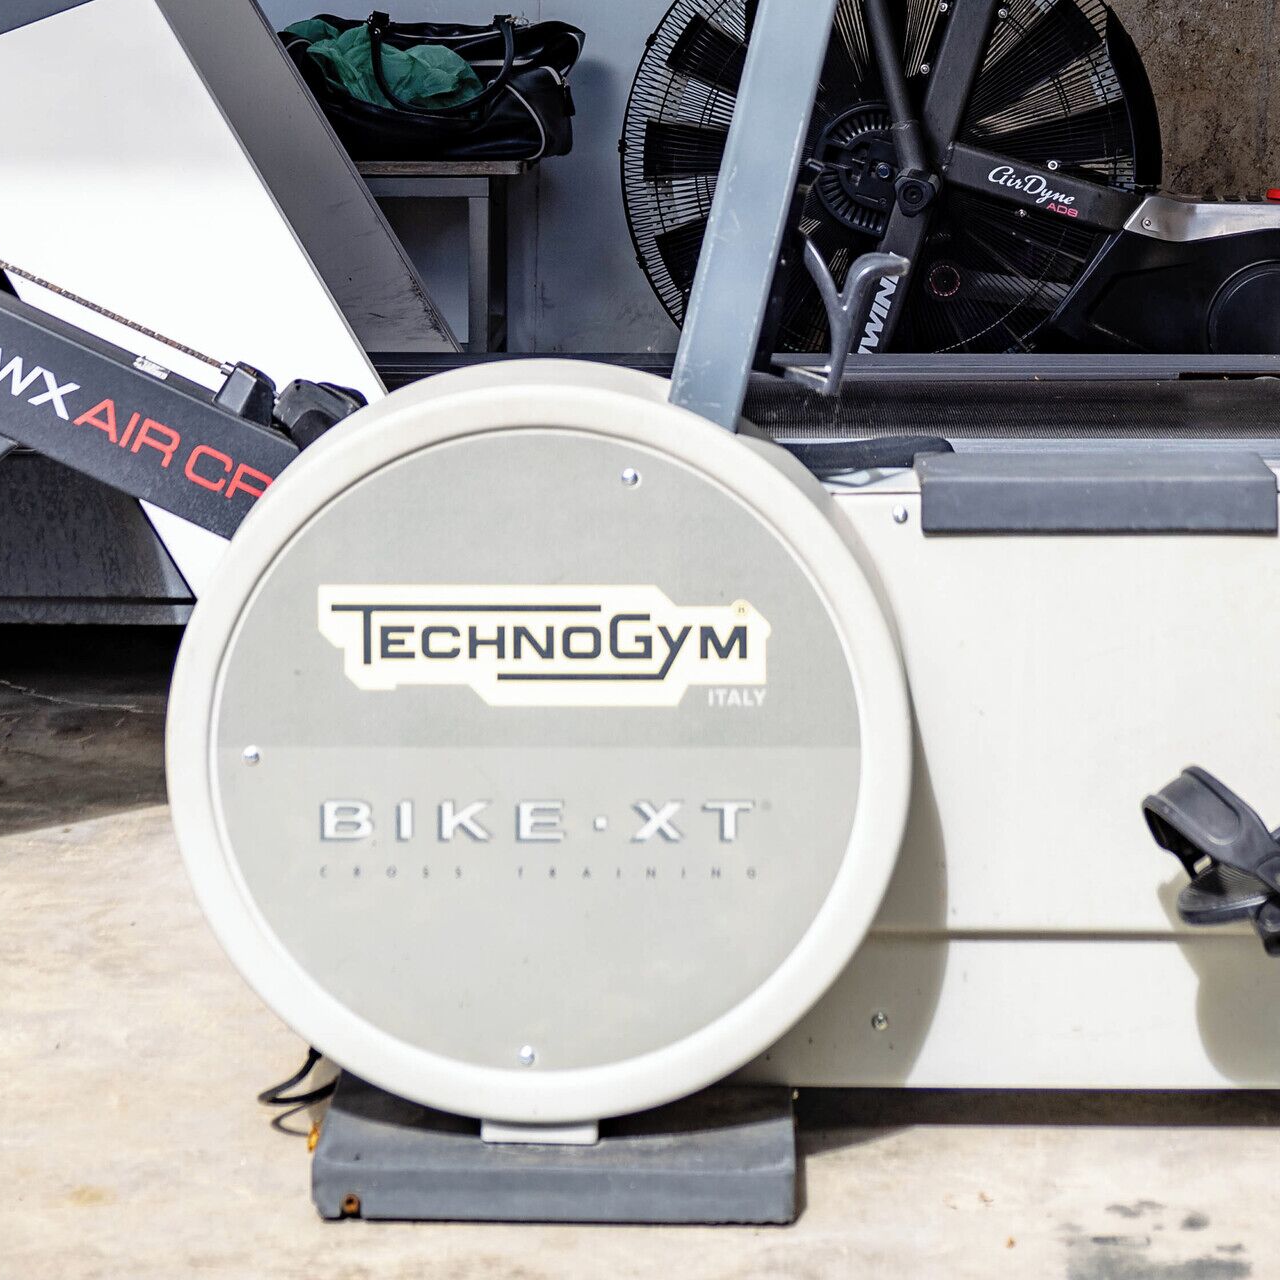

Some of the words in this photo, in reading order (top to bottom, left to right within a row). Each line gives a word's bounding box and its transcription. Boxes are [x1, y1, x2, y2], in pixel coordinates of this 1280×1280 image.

[987, 165, 1075, 205] AirDyne
[857, 251, 901, 354] WIN
[72, 398, 182, 468] AIR
[331, 604, 748, 681] TECHNOGYM
[707, 687, 767, 708] ITALY
[319, 864, 462, 879] CROSS
[516, 864, 758, 879] TRAINING
